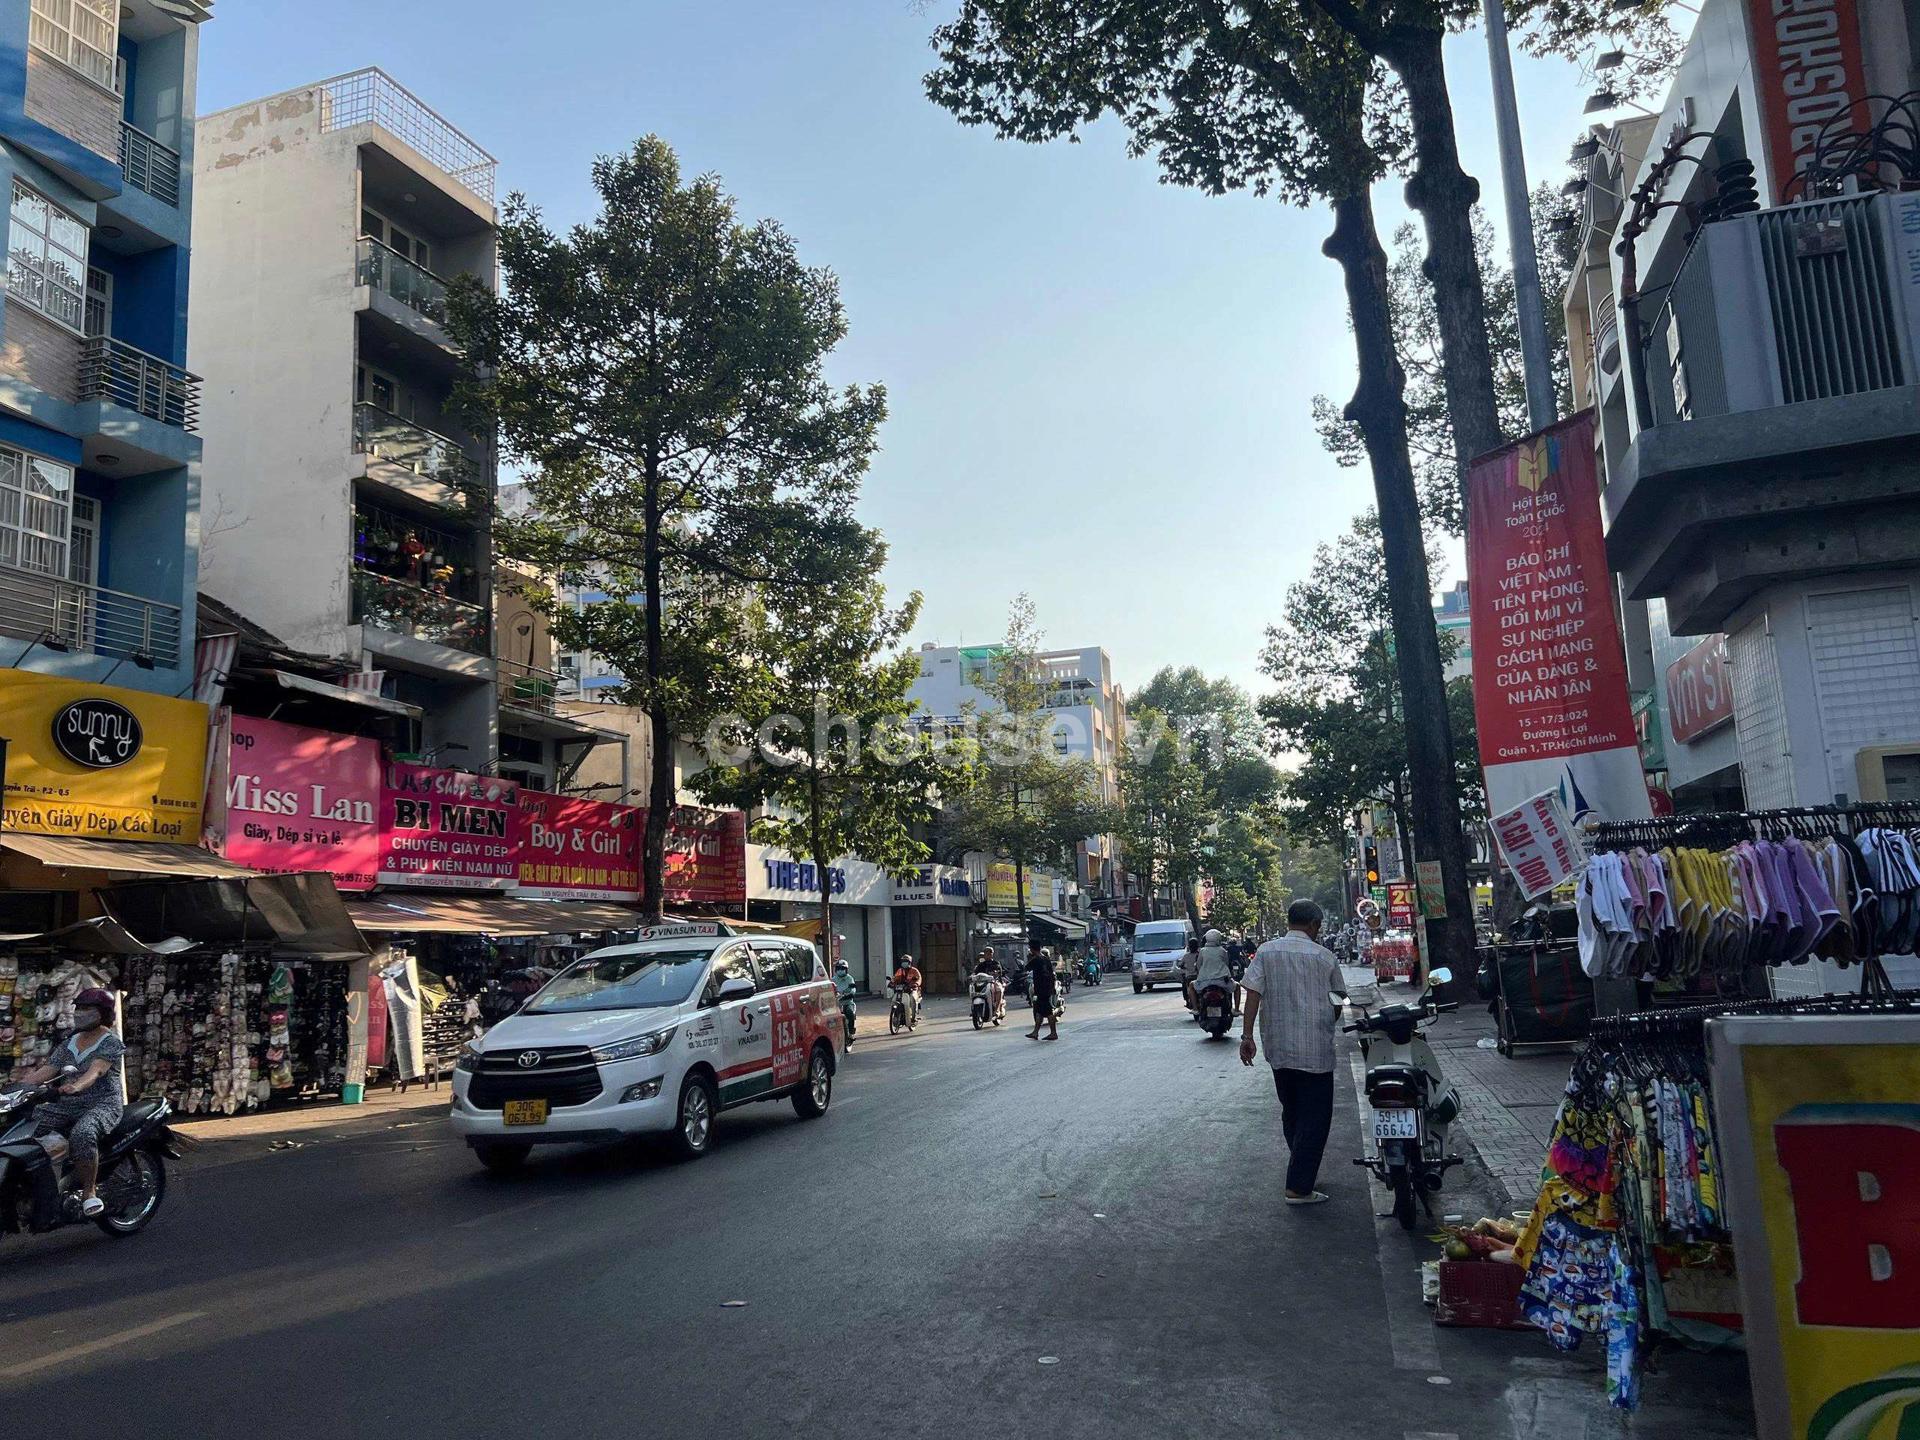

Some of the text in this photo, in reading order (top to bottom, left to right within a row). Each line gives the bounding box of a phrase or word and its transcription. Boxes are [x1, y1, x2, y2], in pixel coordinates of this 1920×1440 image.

[1512, 496, 1532, 511] Hội
[1505, 512, 1533, 527] Toàn
[1507, 552, 1540, 571] BÁO
[1499, 572, 1533, 591] VIỆT
[1539, 564, 1571, 584] NAM
[1492, 590, 1526, 612] TIÊN
[1501, 608, 1529, 628] ĐỔI
[1566, 597, 1583, 614] VÌ
[1502, 619, 1584, 647] SỰ NGHIỆP
[1497, 648, 1544, 667] CÁCH
[1497, 669, 1532, 686] CỦA
[1584, 658, 1598, 671] &
[1508, 685, 1557, 704] NHÂN
[1519, 717, 1531, 728] 15
[1522, 729, 1560, 741] Đường
[1571, 723, 1588, 734] Lợi
[1498, 747, 1527, 758] Quận
[1588, 732, 1617, 745] Minh
[310, 784, 374, 824] Lan
[47, 809, 83, 832] Giày
[87, 812, 117, 833] Dép
[122, 816, 149, 833] Các
[153, 818, 182, 840] Loại
[394, 798, 508, 838] BI MEN
[244, 823, 272, 843] Giày,
[277, 826, 299, 844] Dép
[316, 830, 327, 844] và
[531, 823, 620, 855] Boy & Girl
[392, 837, 508, 857] CHUYÊN GIÀY DÉP
[698, 833, 720, 857] Girl
[1496, 811, 1523, 828] 3
[1516, 855, 1554, 894] 100K
[386, 856, 514, 875] & PHỤ KIỆN NAM NỮ
[800, 863, 845, 894] BLES
[894, 893, 933, 901] BLUES
[658, 925, 716, 937] VINASUN TAXI
[1379, 1110, 1408, 1123] 59-L1
[1376, 1124, 1413, 1136] 666.42
